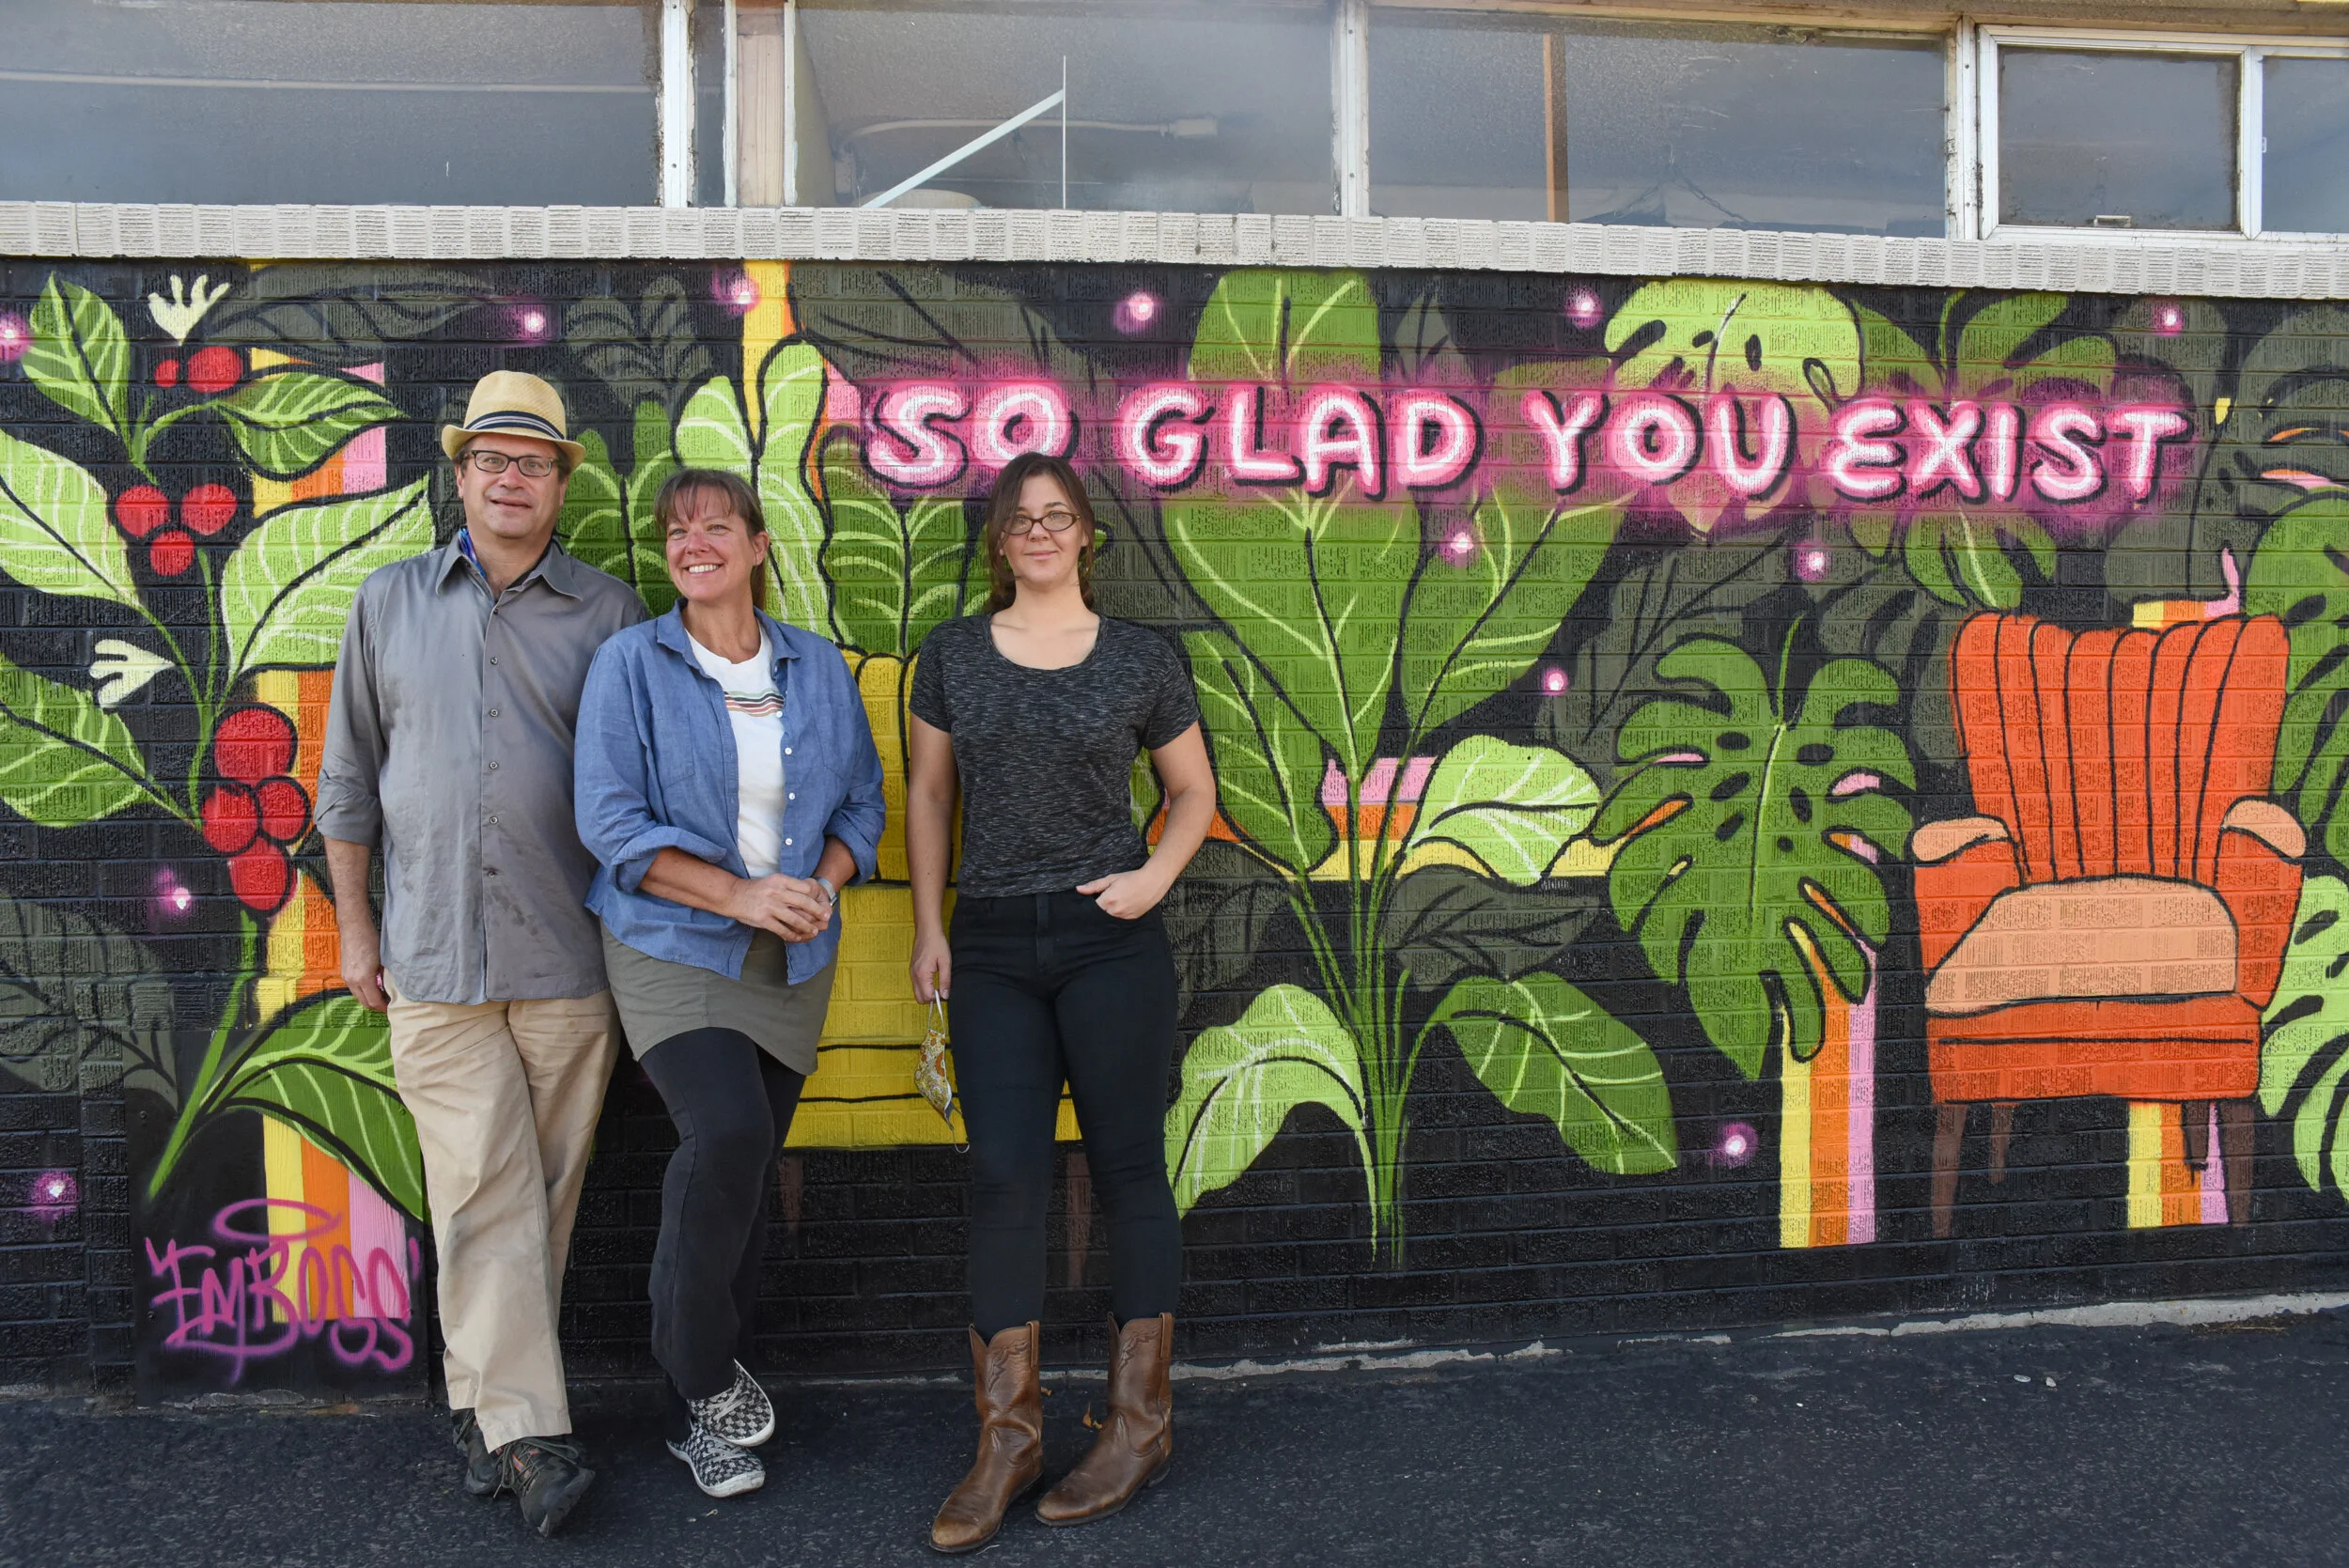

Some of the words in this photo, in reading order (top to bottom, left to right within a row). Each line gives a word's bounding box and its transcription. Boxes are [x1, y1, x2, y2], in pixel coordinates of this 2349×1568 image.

[860, 378, 1080, 489] SO
[1122, 380, 1483, 501] GLAD
[1520, 389, 1796, 498] YOU
[1826, 396, 2195, 505] EXIST
